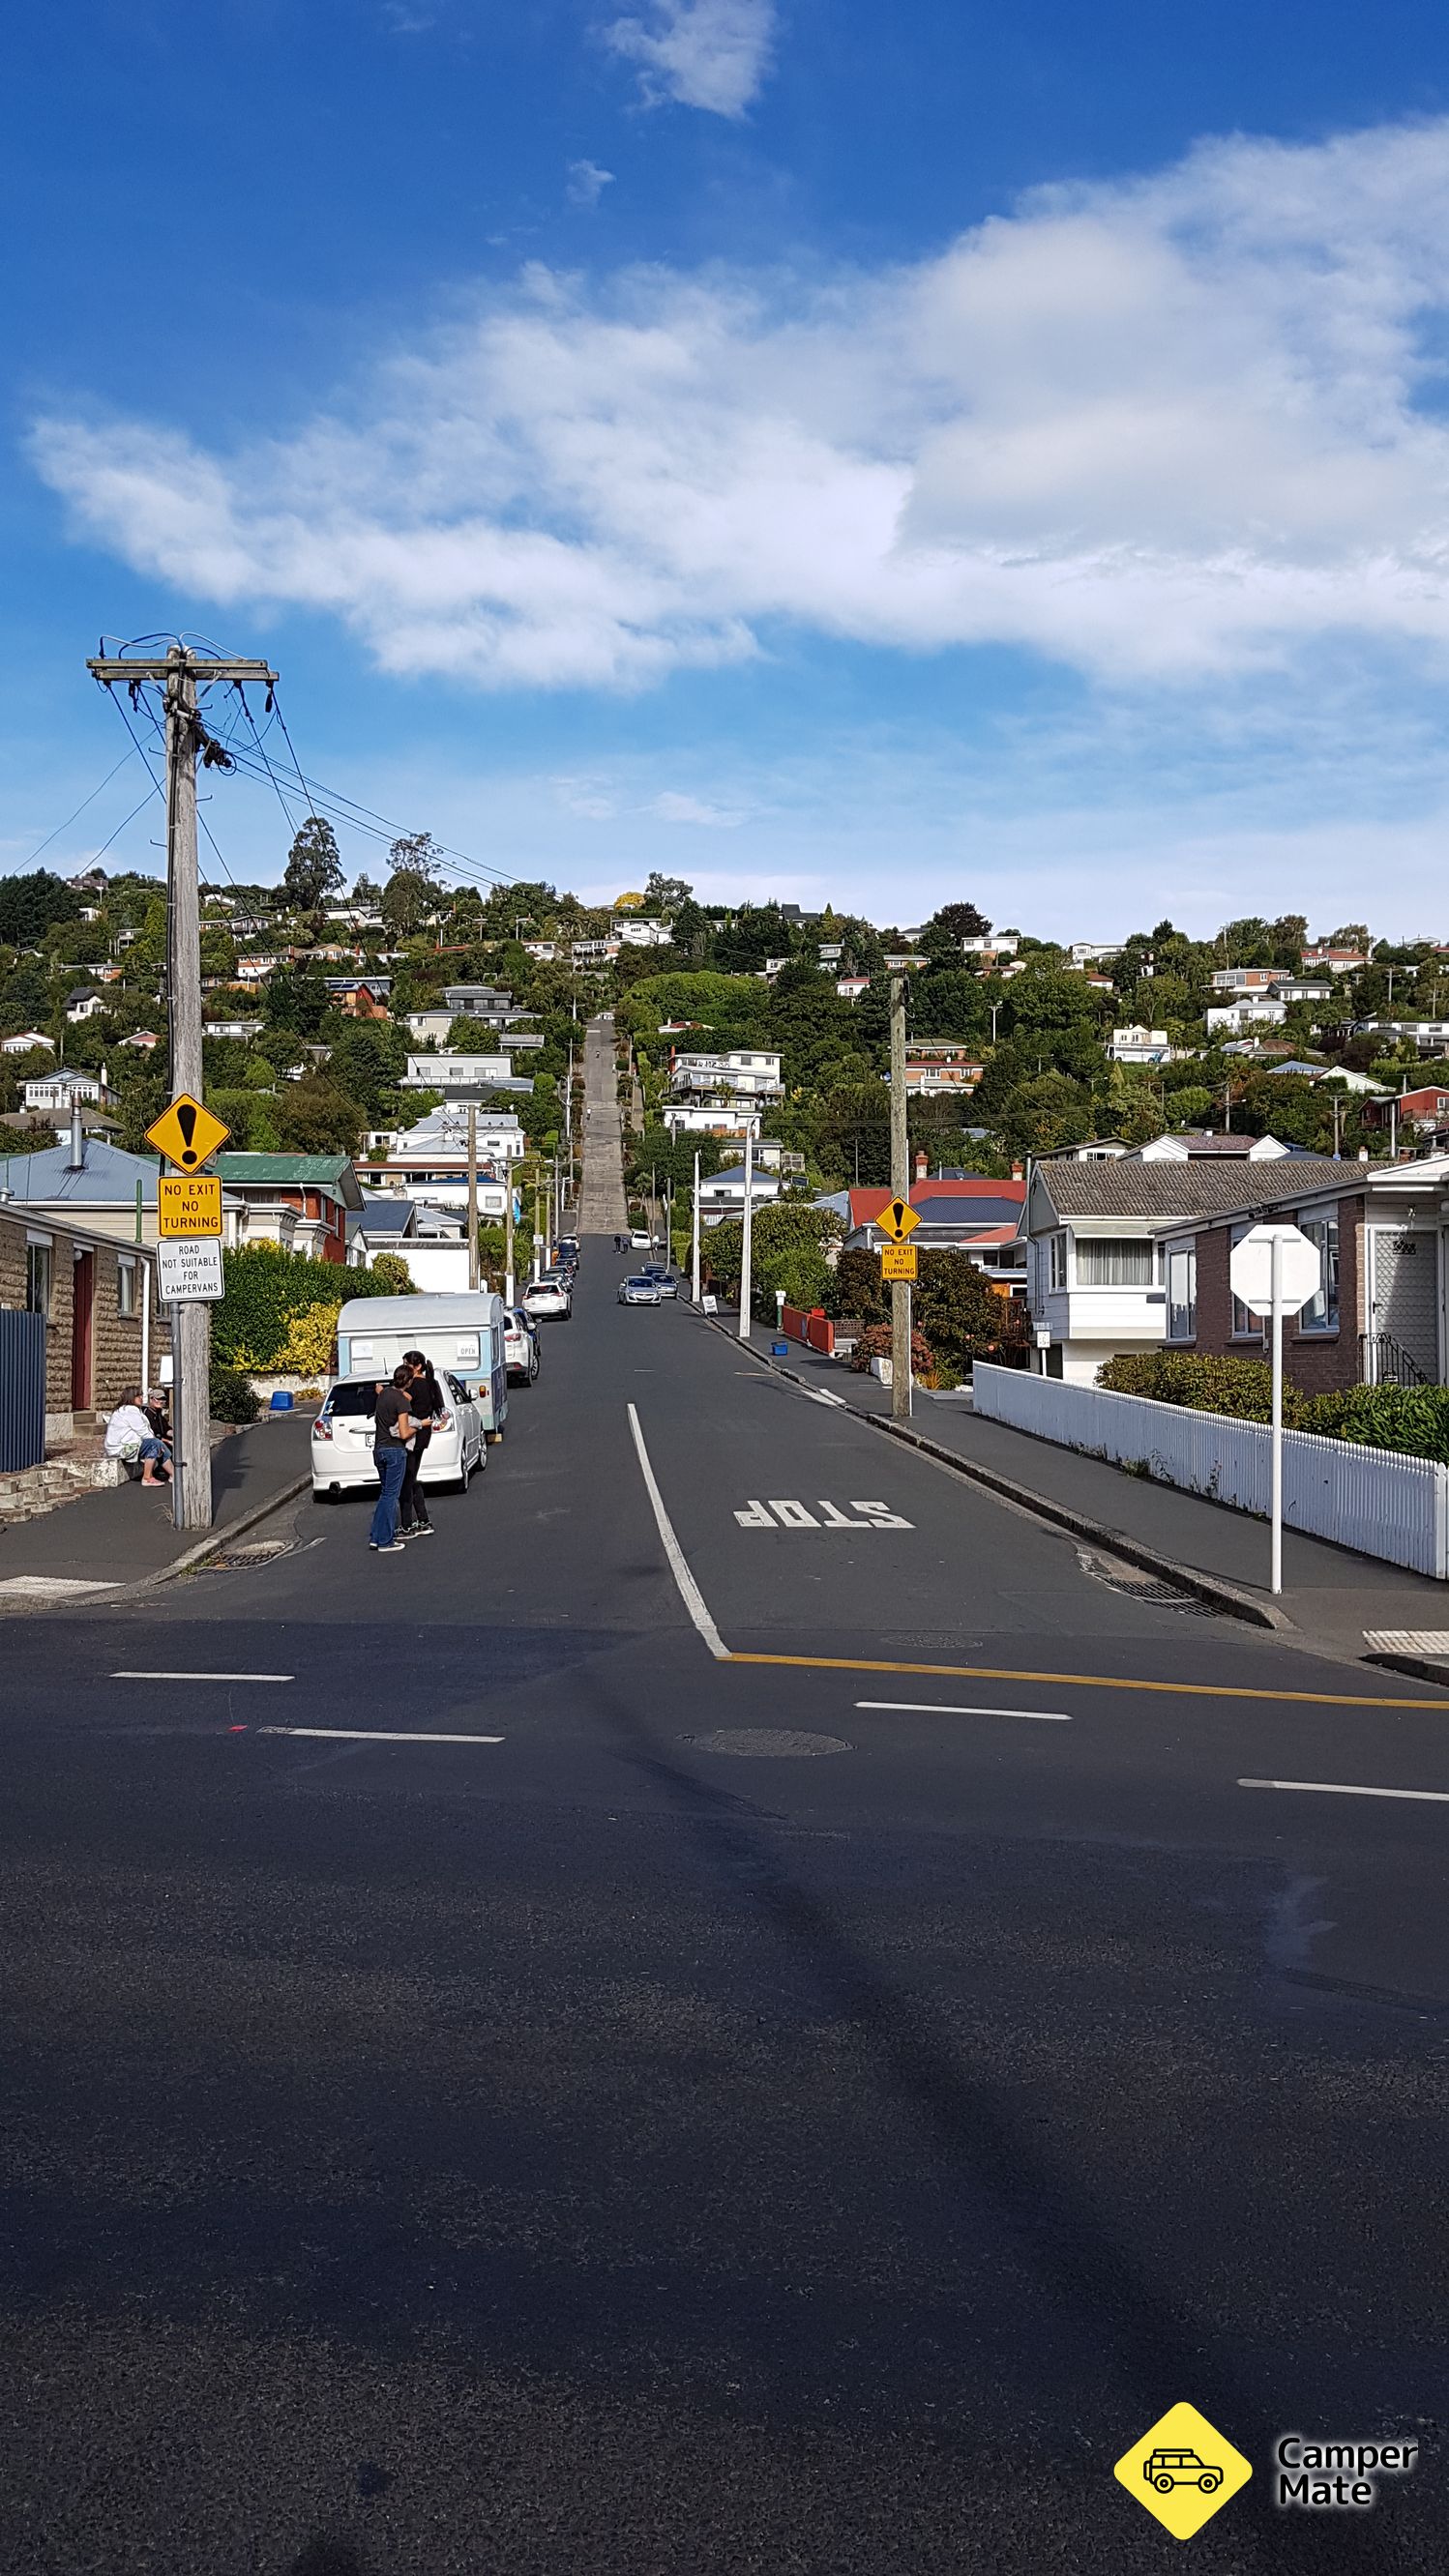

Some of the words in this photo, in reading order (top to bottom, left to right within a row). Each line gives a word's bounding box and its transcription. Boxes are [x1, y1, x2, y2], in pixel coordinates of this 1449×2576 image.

[164, 1185, 181, 1195] NO
[189, 1185, 215, 1195] EXIT
[182, 1201, 198, 1212] NO
[163, 1217, 219, 1228] TURNING
[179, 1245, 199, 1255] ROAD
[162, 1259, 176, 1269] NOT
[181, 1257, 218, 1268] SUITABLE
[183, 1271, 198, 1280] FOR
[165, 1282, 219, 1295] CAMPERVANS
[733, 1500, 917, 1529] STOP
